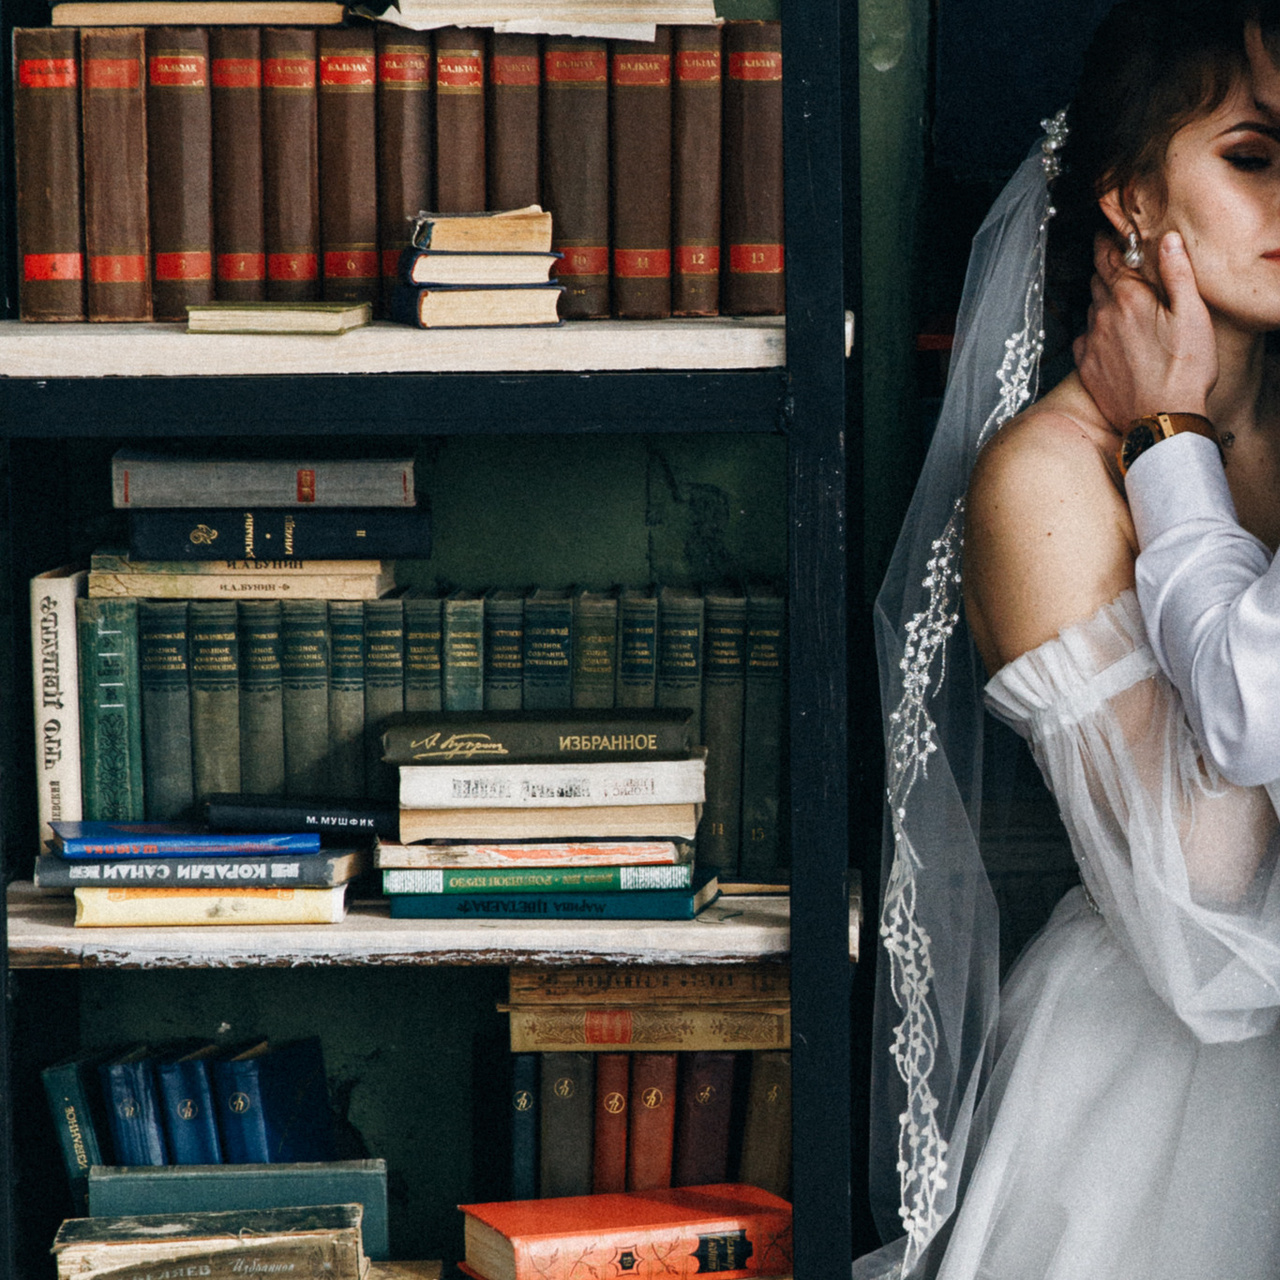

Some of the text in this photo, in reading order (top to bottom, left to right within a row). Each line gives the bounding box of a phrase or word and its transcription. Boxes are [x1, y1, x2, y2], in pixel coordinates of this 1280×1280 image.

[327, 62, 368, 73] БАЛЬЗАК
[690, 253, 706, 265] 12
[750, 252, 766, 265] 13
[40, 595, 65, 710] ДЕЛАТЬ?
[43, 718, 62, 770] ЧТО
[558, 733, 658, 752] ИЗБРАННОЕ
[306, 815, 375, 828] М. МУШФИК
[103, 862, 267, 880] КОРАБЛИ САНДИ
[449, 876, 487, 888] КРУЗО
[470, 898, 607, 914] МАРИНА ЦВЕТАЕВА
